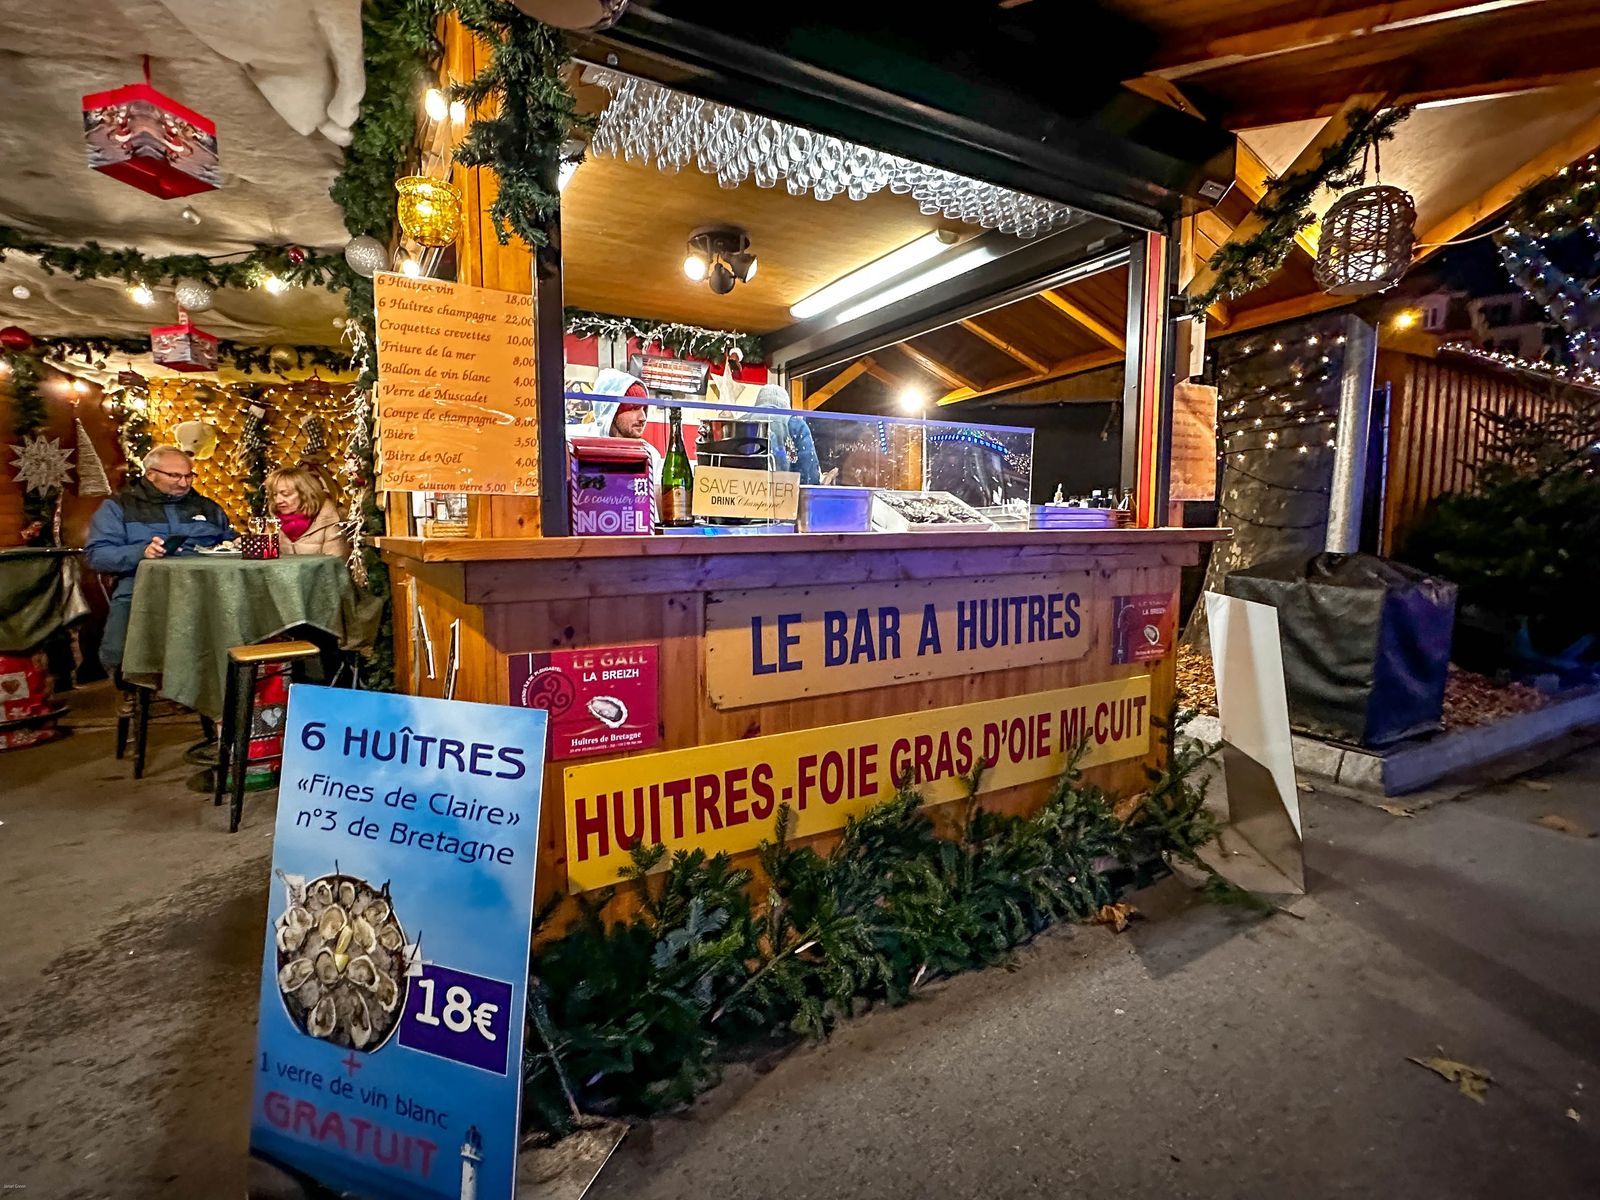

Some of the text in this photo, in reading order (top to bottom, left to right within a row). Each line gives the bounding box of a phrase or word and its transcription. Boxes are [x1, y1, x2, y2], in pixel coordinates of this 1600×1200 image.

[378, 275, 385, 285] 6
[436, 284, 454, 295] vin
[505, 294, 534, 306] 18,00
[379, 297, 534, 326] 6 Huîtres champagne 22,00
[380, 319, 534, 347] Croquettes crevettes 10,00
[381, 340, 535, 367] Friture de la mer 8,00
[382, 362, 536, 388] Ballon de vin blanc 4,00
[383, 384, 536, 408] Verre de Muscadet 5,00
[383, 407, 536, 427] Coupe de champagne 8,00
[384, 428, 537, 447] Bière 3,50
[385, 450, 537, 468] Bière de Noël 4,00
[385, 471, 416, 484] Softs
[459, 483, 483, 492] verre
[486, 483, 506, 493] 5,00
[700, 477, 794, 498] SAVE WATER
[592, 495, 634, 504] courrier
[711, 496, 736, 505] DRINK
[578, 506, 648, 533] NOËL
[752, 592, 1081, 676] LE BAR A HUITRES
[583, 668, 639, 682] LA BREIZH
[301, 722, 526, 780] 6 HUÎTRES
[600, 735, 609, 743] de
[610, 732, 642, 742] Bretagne
[890, 726, 973, 789] GRAS
[984, 712, 1052, 770] D'OIE
[1060, 696, 1147, 753] MI-CUIT
[298, 774, 520, 826] «Fines de Claire»
[296, 808, 514, 866] n°3 de Bretagne
[415, 978, 498, 1042] 18€
[260, 1052, 449, 1130] 1 verre de vin blanc
[264, 1090, 440, 1178] GRATUIT
